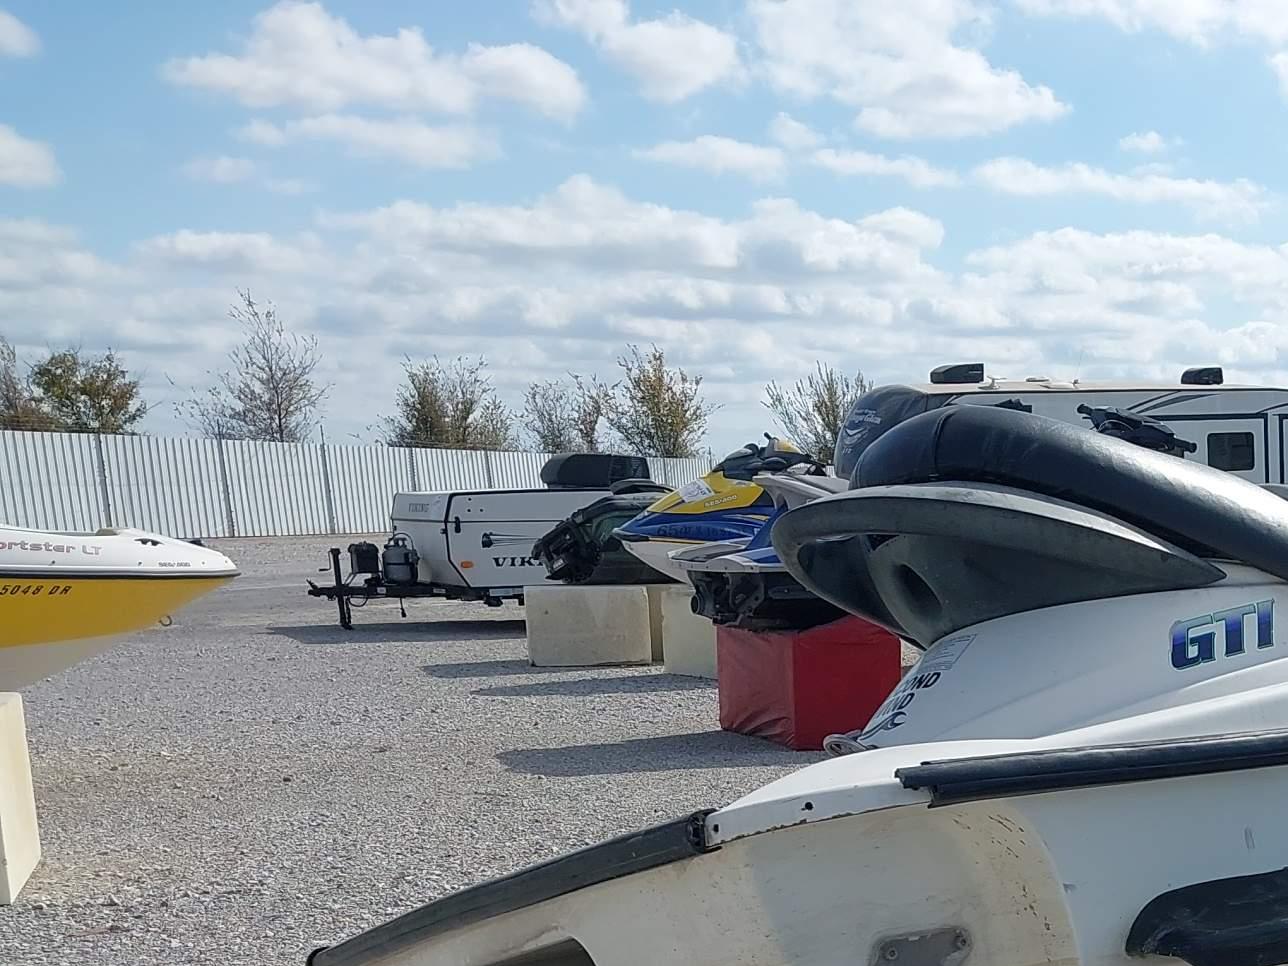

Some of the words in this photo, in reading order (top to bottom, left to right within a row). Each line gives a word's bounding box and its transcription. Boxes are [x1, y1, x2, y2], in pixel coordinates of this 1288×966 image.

[82, 544, 102, 556] LT
[0, 584, 44, 596] 5048
[48, 585, 73, 596] DR
[1169, 598, 1274, 670] GTI
